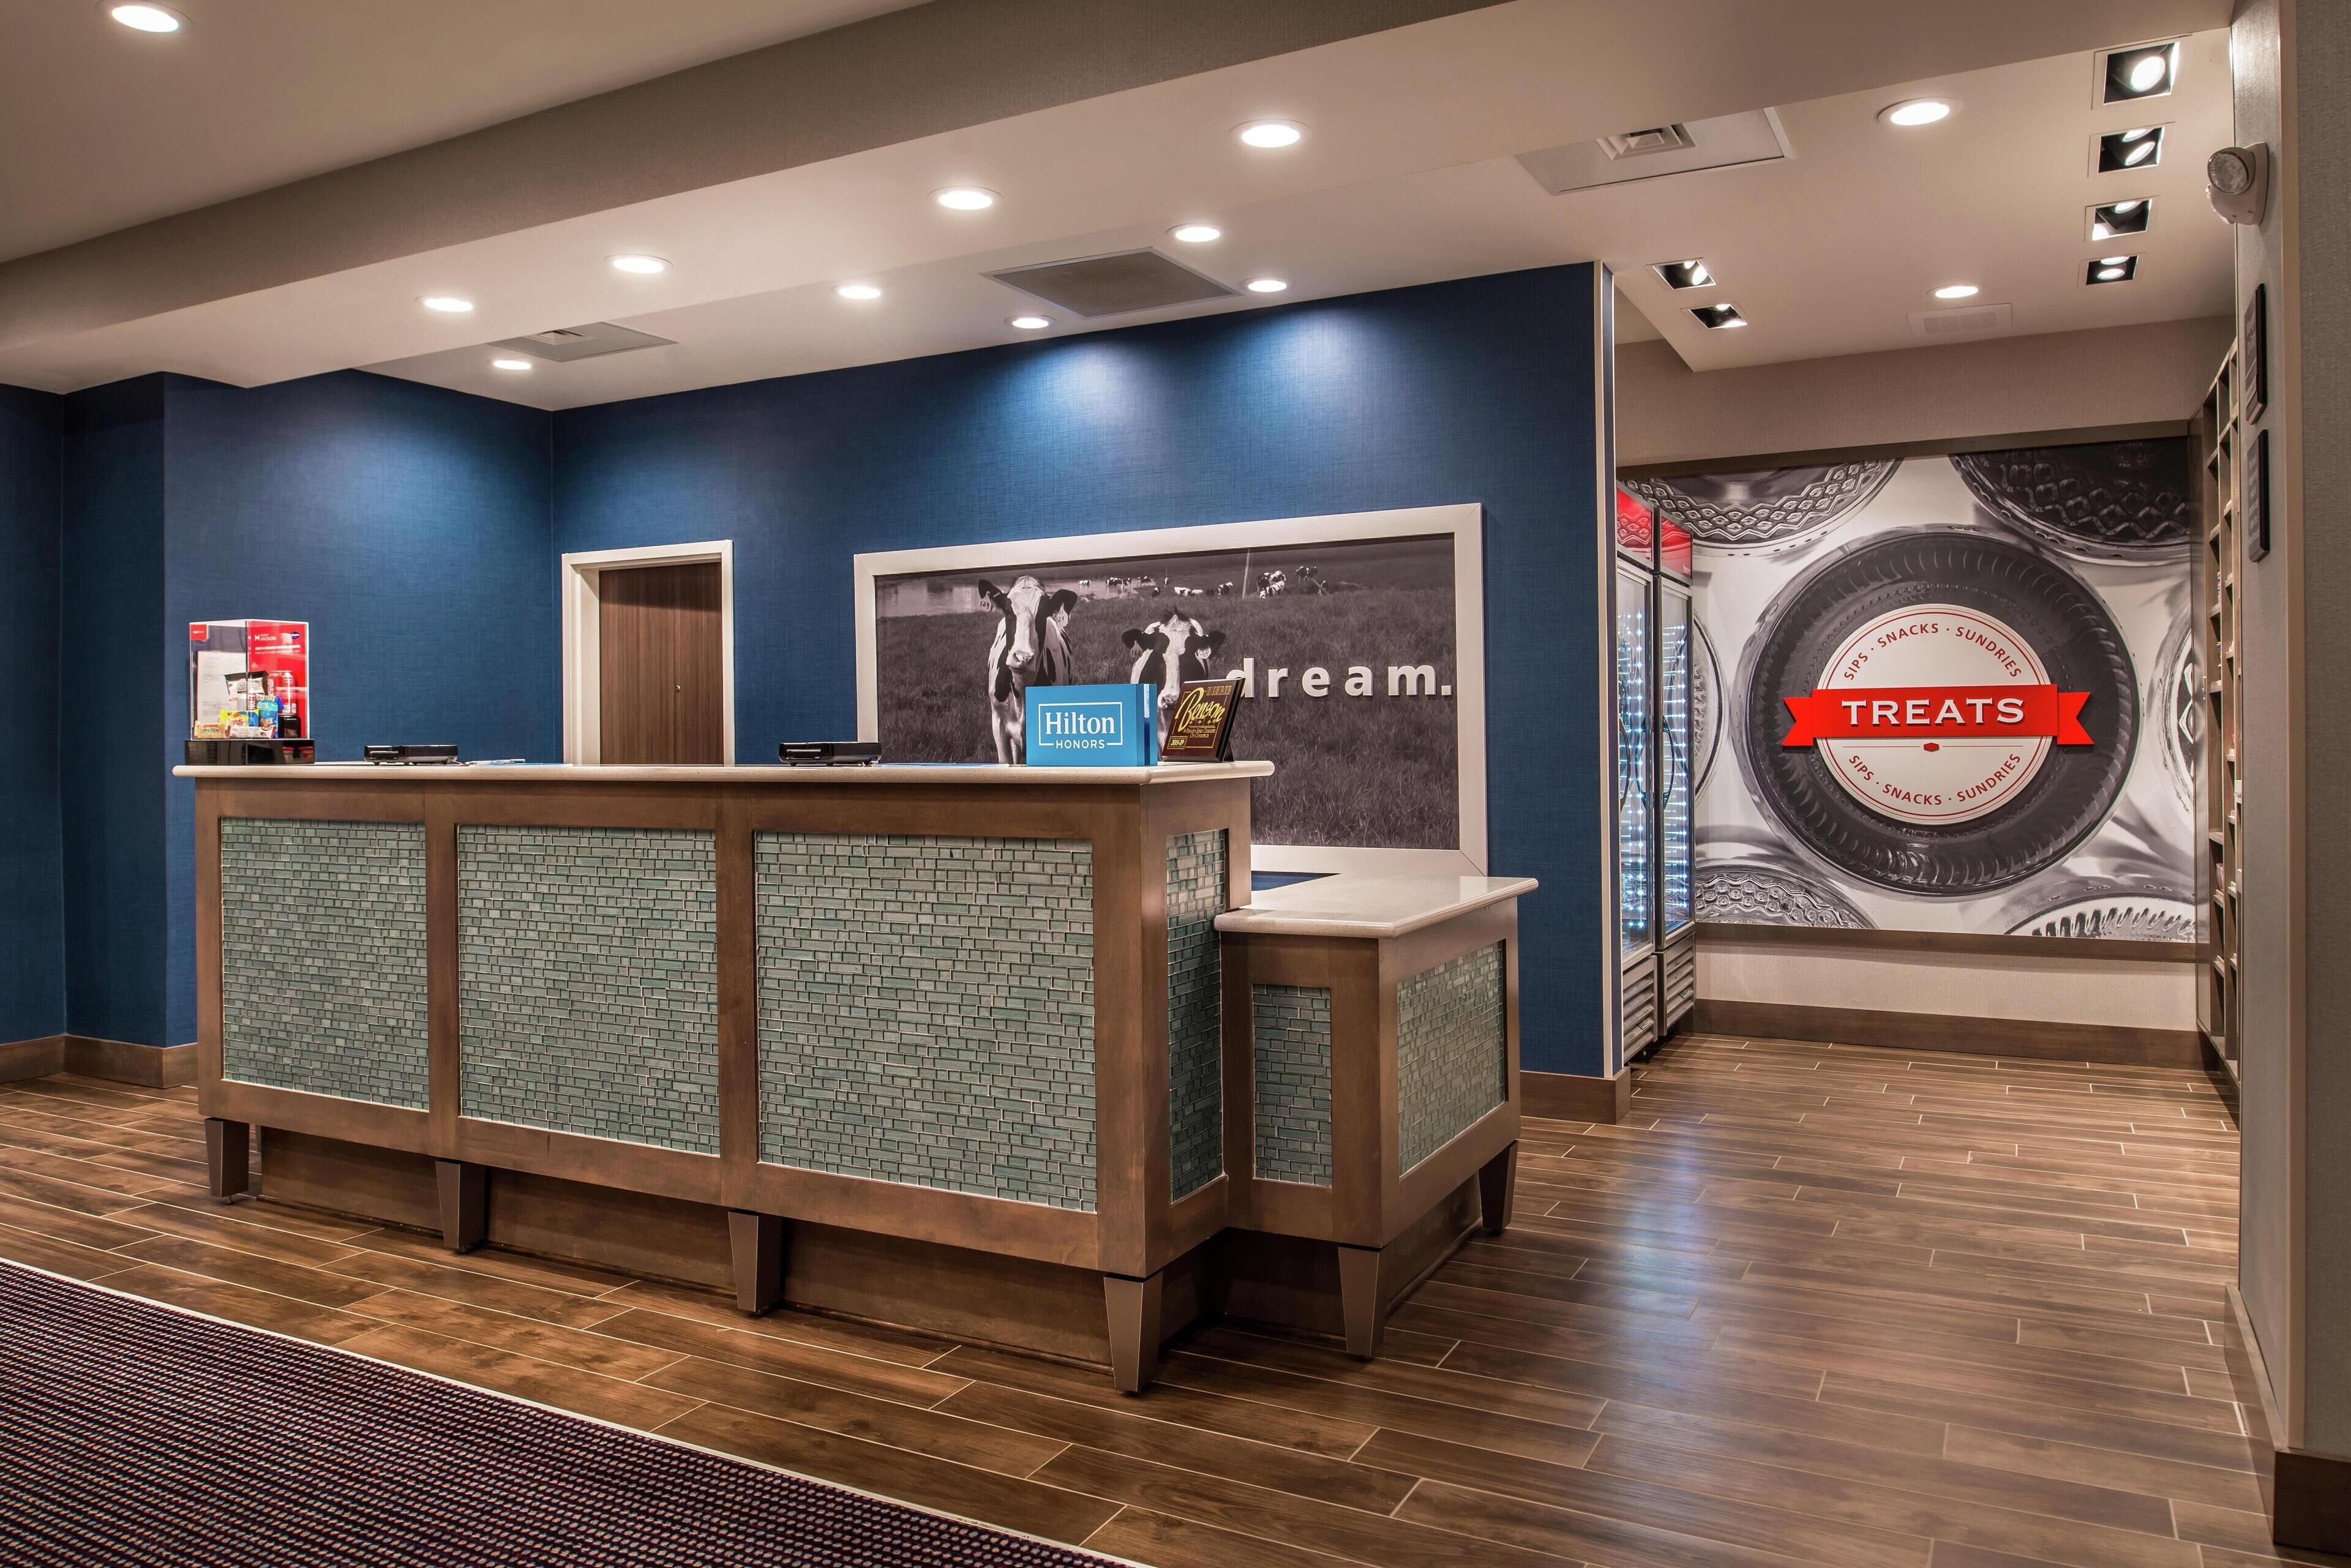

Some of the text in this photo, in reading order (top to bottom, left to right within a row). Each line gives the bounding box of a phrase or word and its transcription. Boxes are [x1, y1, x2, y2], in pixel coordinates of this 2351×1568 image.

[980, 601, 990, 610] 129
[1843, 623, 2022, 680] SIPS SNACKS SUNDRIES
[1226, 658, 1452, 698] dream.
[1044, 711, 1116, 735] Hilton
[1175, 687, 1226, 732] Benson
[1841, 698, 2025, 726] TREATS
[1056, 739, 1105, 749] HONORS
[1848, 753, 2022, 806] SIPS SNACKS SUNDRIES
